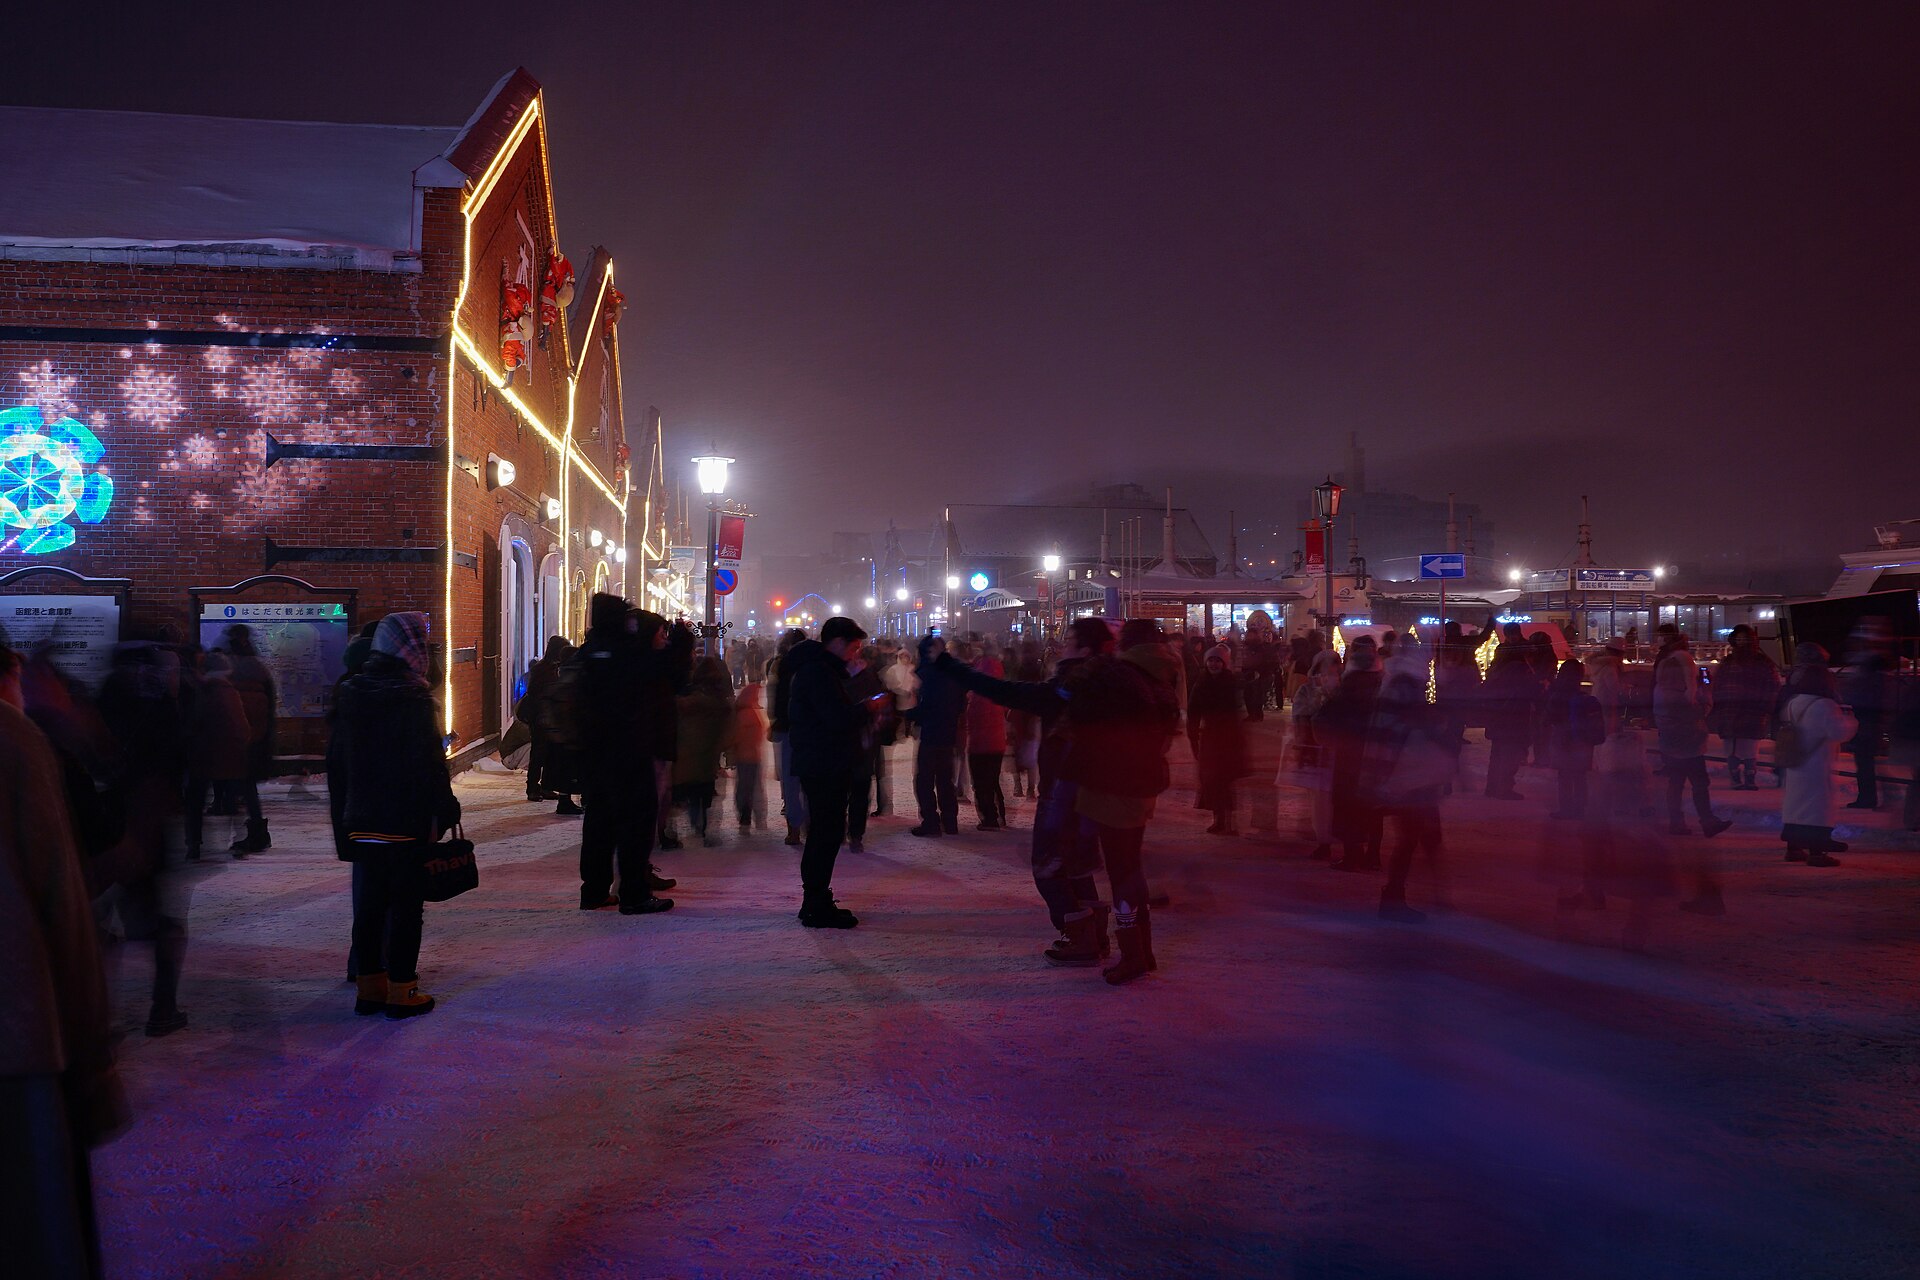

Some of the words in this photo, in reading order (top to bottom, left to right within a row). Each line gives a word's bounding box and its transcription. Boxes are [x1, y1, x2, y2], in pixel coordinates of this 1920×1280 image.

[15, 607, 73, 616] 函館港と倉庫群
[241, 607, 326, 616] はこだて観光案内
